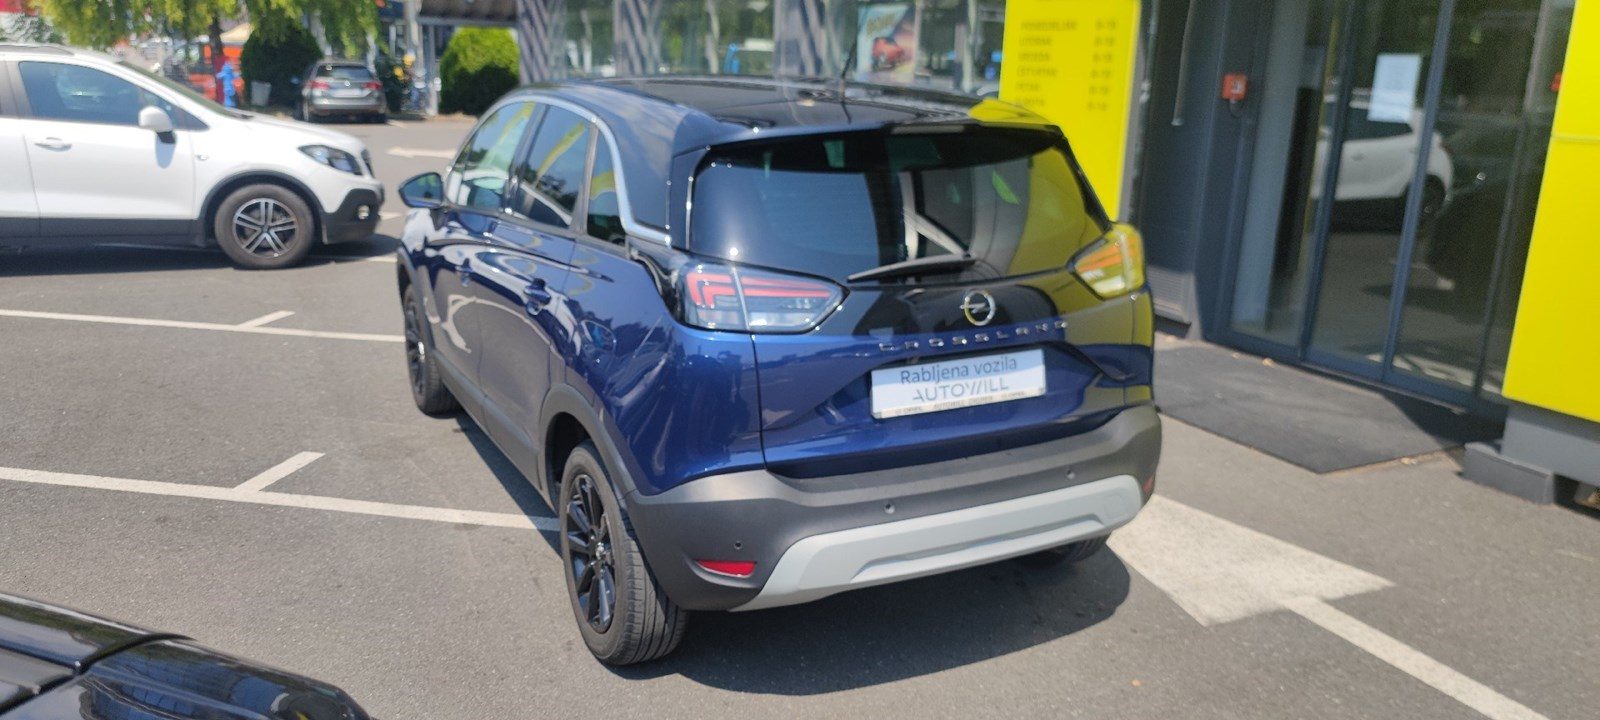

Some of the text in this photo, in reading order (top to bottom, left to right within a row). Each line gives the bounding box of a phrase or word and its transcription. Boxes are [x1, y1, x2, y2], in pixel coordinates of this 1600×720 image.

[878, 321, 1068, 352] CROSSLAND
[900, 356, 1018, 385] Rabljena vozila
[912, 377, 1010, 402] AUTOWILL
